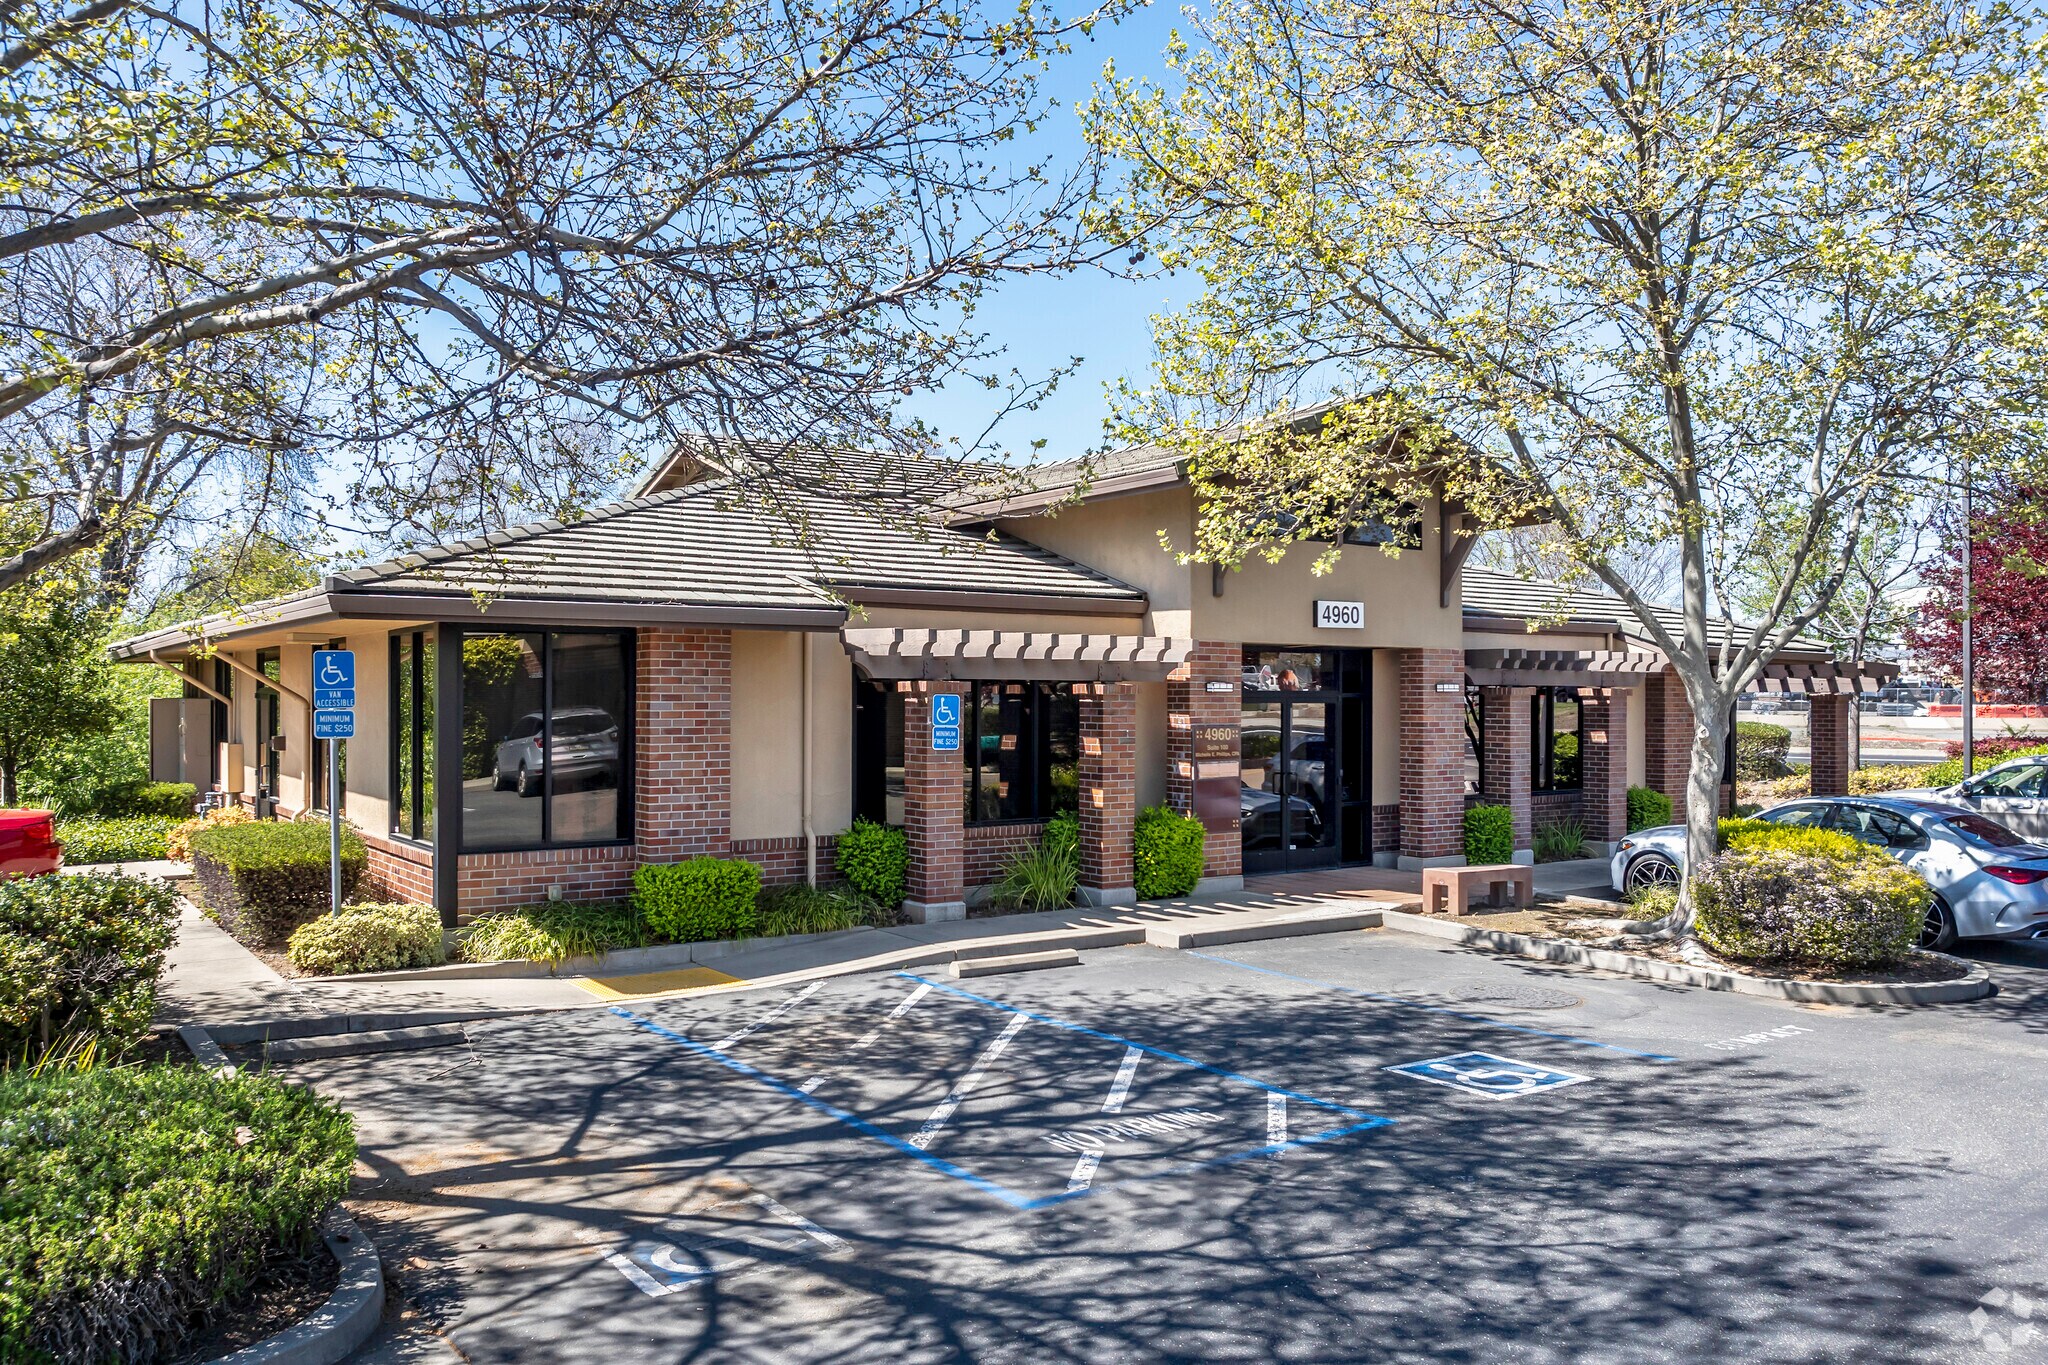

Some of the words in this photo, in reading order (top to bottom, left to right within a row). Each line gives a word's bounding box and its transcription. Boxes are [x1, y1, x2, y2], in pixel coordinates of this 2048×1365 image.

[1322, 604, 1360, 624] 4960
[316, 699, 354, 707] ACCESSIBLE
[316, 724, 332, 732] FINE
[335, 724, 353, 732] $250
[1204, 728, 1232, 740] 4960
[1039, 1130, 1106, 1153] NO
[1088, 1107, 1226, 1142] PARKING
